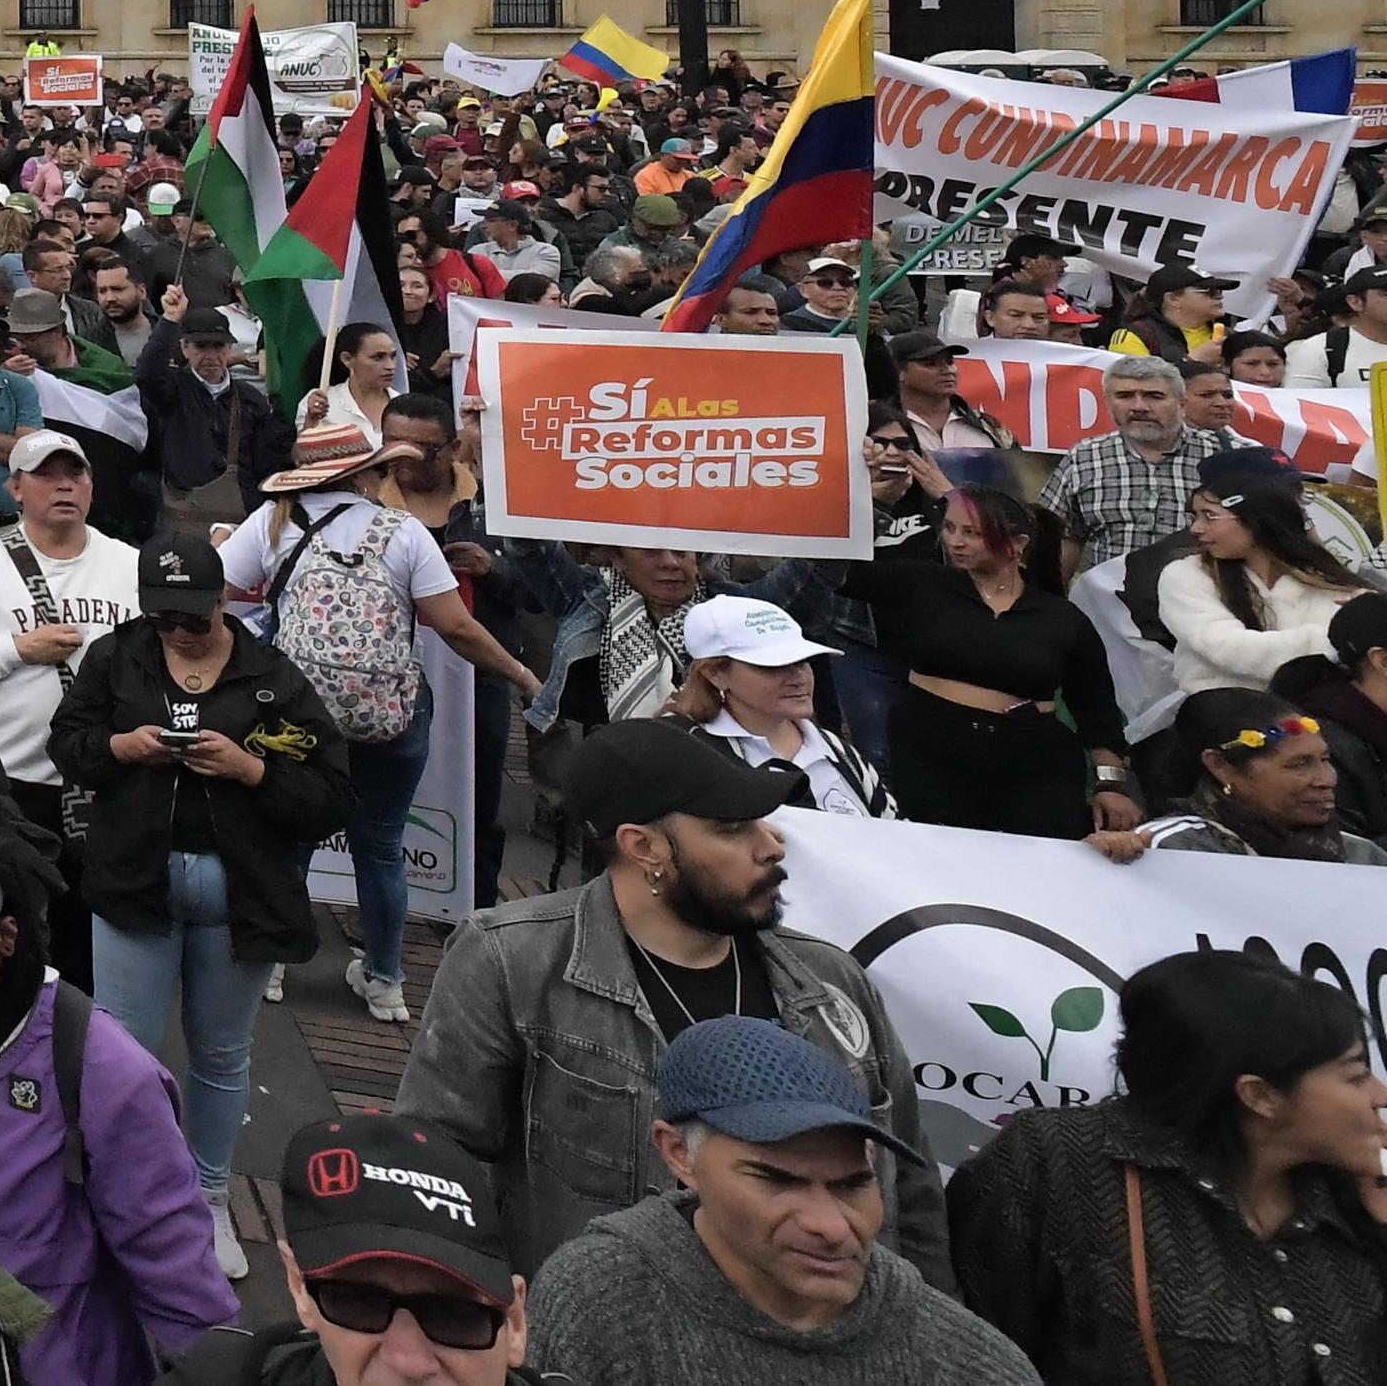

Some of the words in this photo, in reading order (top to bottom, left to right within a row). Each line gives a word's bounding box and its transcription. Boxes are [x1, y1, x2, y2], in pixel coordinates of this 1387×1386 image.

[281, 63, 317, 76] ANUC
[938, 95, 1332, 216] CUNDINAMARCA
[875, 170, 1208, 266] PRESENTE
[570, 422, 817, 454] Reformas
[574, 452, 820, 490] Sociales
[12, 599, 133, 634] PAADENA
[172, 703, 198, 716] SOY
[362, 1163, 473, 1203] HONDA
